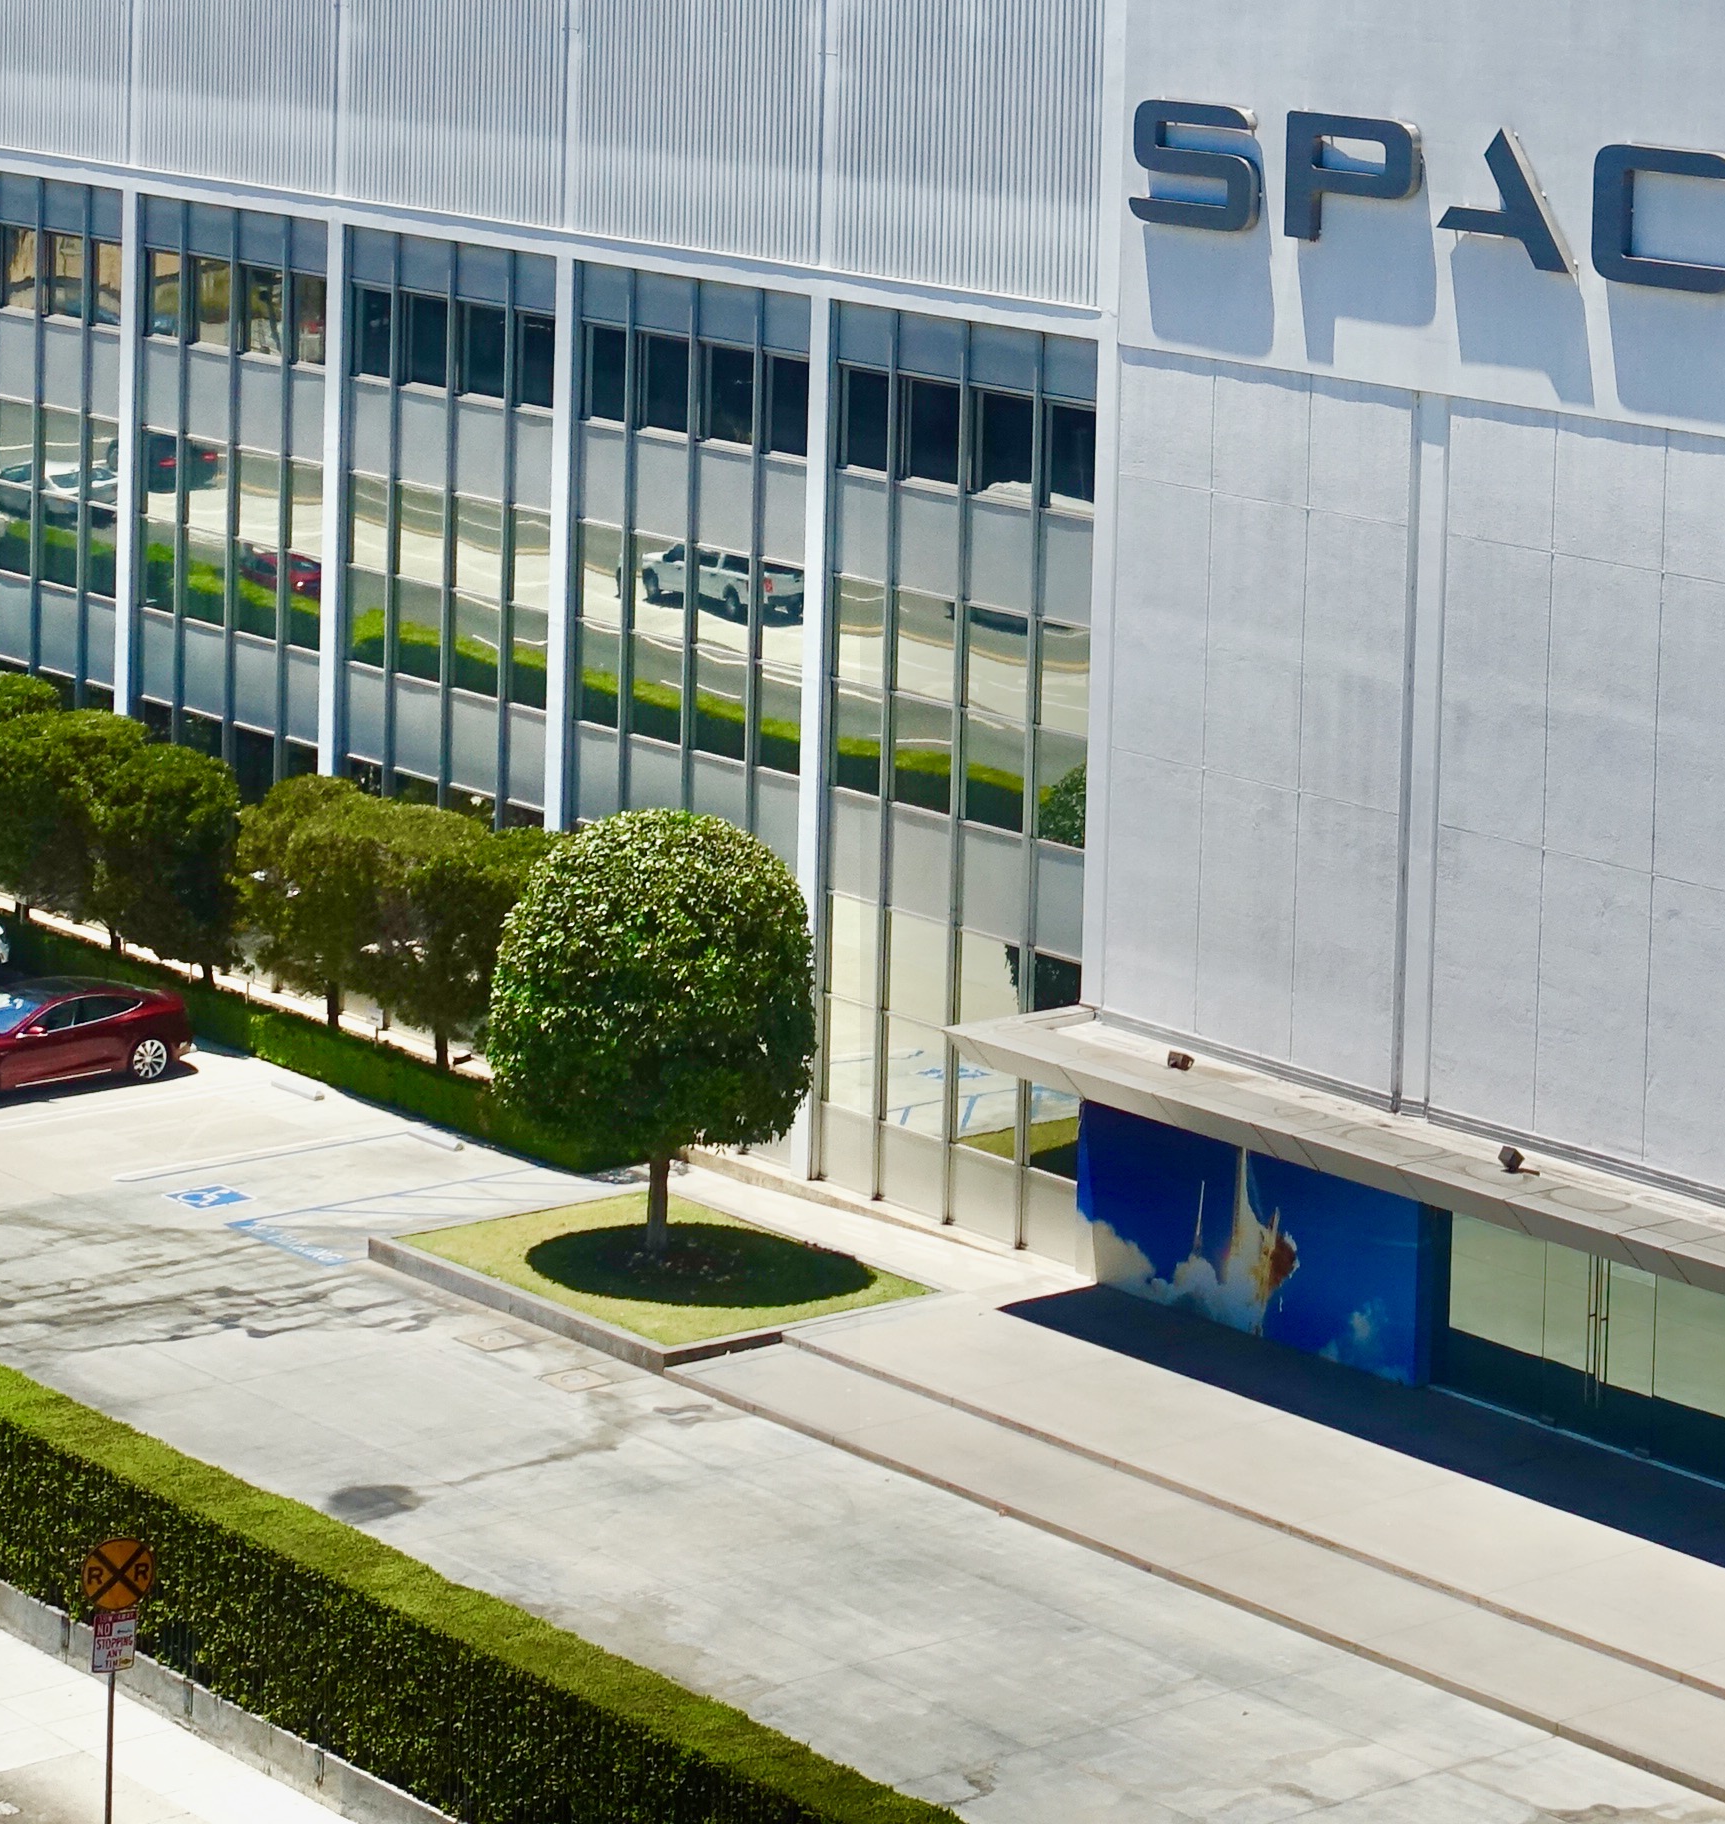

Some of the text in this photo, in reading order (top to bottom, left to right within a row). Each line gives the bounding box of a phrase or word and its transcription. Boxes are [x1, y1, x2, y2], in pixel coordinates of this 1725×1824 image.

[87, 1562, 150, 1585] R R
[97, 1623, 111, 1636] NO
[97, 1636, 133, 1650] STOPPING
[107, 1649, 122, 1658] ANY
